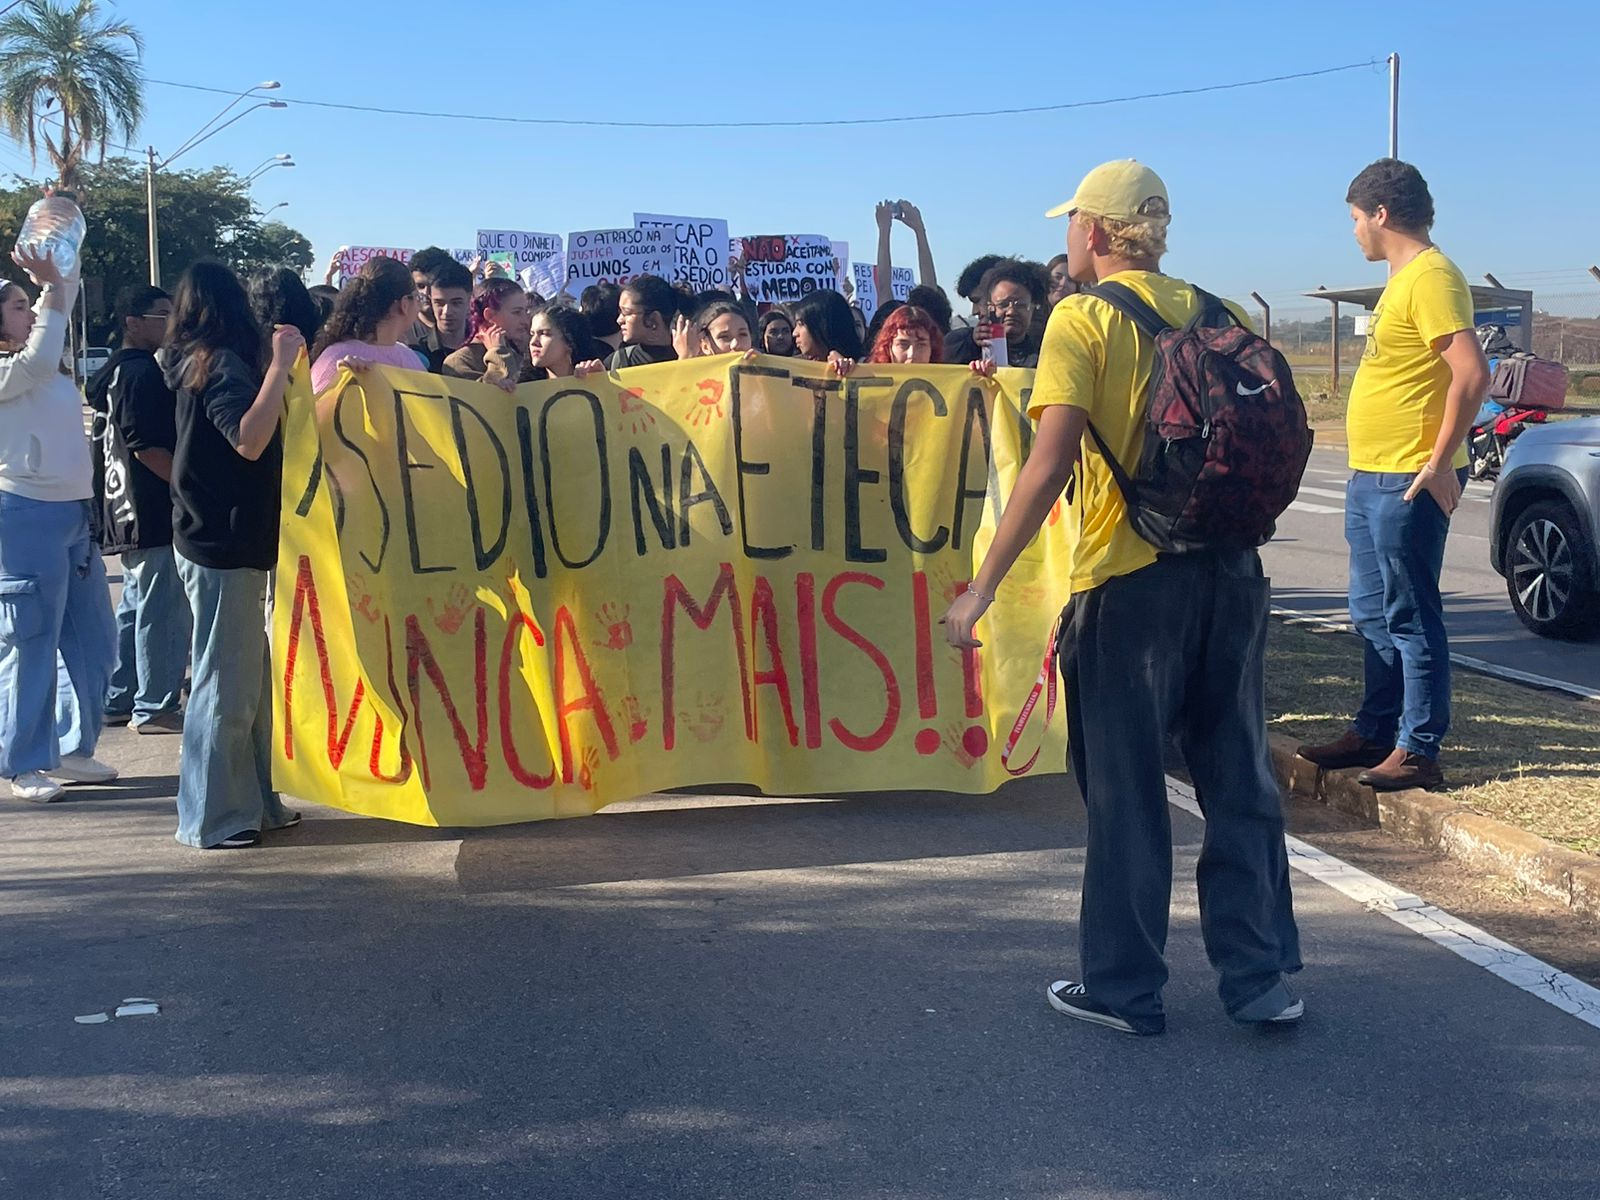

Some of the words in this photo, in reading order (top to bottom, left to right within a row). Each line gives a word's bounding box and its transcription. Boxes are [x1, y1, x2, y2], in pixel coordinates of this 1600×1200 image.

[479, 233, 505, 249] QUE
[510, 233, 518, 249] O
[577, 235, 588, 247] O
[594, 230, 643, 246] ATRASO
[646, 231, 661, 242] NA
[521, 250, 557, 263] COMPR
[622, 245, 657, 256] COLOCA
[660, 244, 671, 254] OS
[705, 247, 718, 266] O
[568, 258, 631, 280] ALUNOS
[643, 259, 661, 271] EM
[745, 261, 801, 277] ESTUDAR
[806, 259, 835, 276] COM
[854, 264, 872, 278] RES
[296, 381, 613, 578] SEDIO
[628, 440, 732, 557] NA
